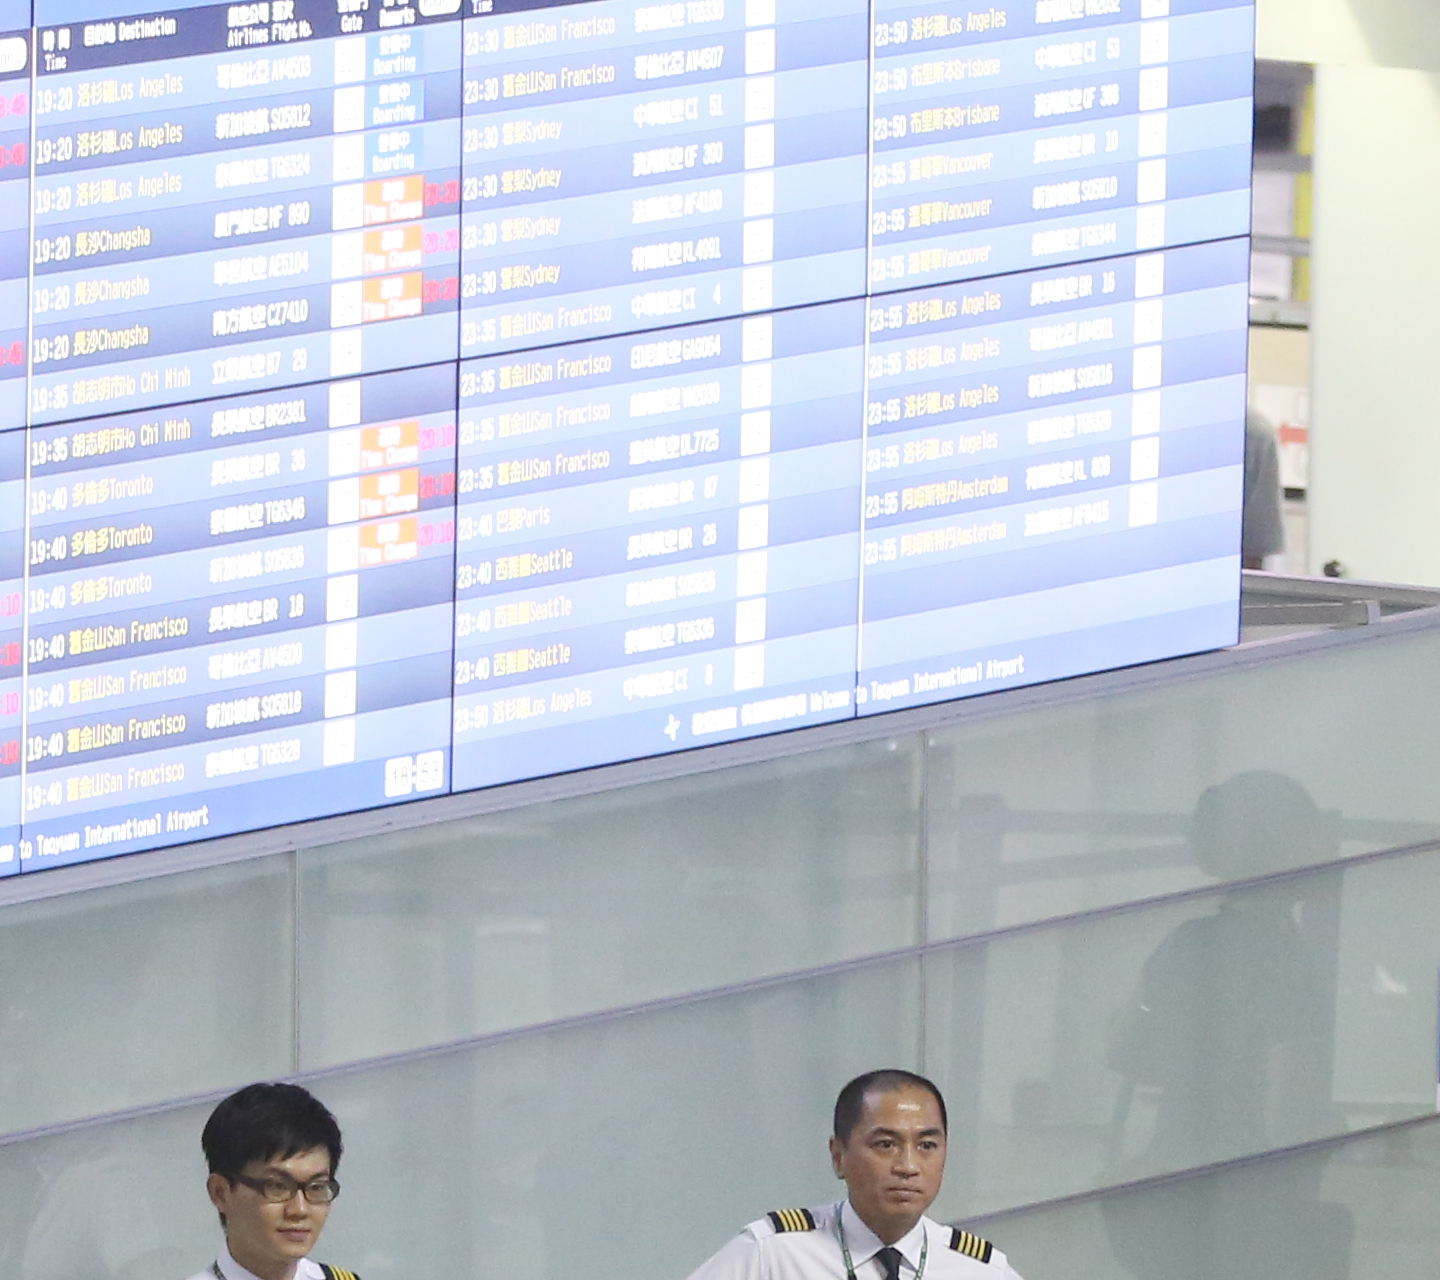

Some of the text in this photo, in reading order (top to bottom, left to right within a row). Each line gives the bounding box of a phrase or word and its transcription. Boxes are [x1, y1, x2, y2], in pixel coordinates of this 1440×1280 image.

[465, 28, 499, 54] 23:30
[562, 14, 615, 40] Francisco
[37, 88, 72, 114] 19:20
[139, 74, 183, 98] Angeles
[875, 68, 907, 94] 23:50
[464, 173, 497, 200] 23:30
[874, 163, 905, 189] 23:55
[35, 237, 70, 263] 19:20
[33, 385, 68, 412] 19:35
[141, 371, 159, 392] Chi
[165, 367, 190, 389] Minh
[866, 489, 898, 518] 23:55
[459, 514, 492, 539] 23:40
[31, 535, 66, 564] 19:40
[458, 563, 491, 589] 23:40
[986, 655, 1024, 681] Airport
[29, 683, 63, 711] 19:40
[130, 666, 187, 694] Francisco
[390, 756, 439, 789] 18:53
[20, 839, 32, 860] to
[84, 814, 162, 846] International
[167, 805, 209, 834] Airport
